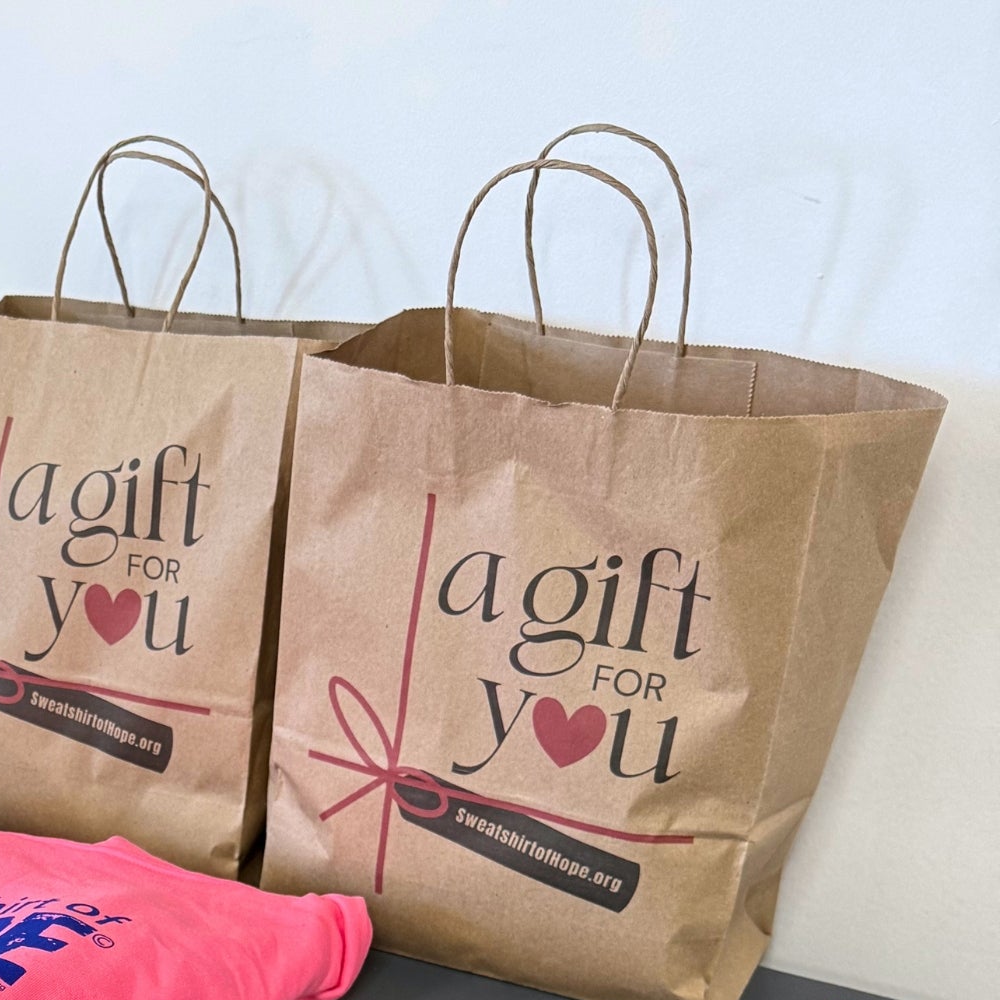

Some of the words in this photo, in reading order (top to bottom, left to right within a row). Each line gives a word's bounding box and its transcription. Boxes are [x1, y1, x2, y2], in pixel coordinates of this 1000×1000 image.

[8, 462, 62, 525] a
[60, 444, 211, 568] gift
[127, 553, 181, 584] FOR
[437, 551, 507, 623] a
[508, 547, 712, 677] gift
[593, 664, 668, 702] FOR
[30, 690, 162, 756] SweatshirtofHope.org
[455, 807, 623, 893] SweatshirtofHope.org
[66, 903, 133, 927] of
